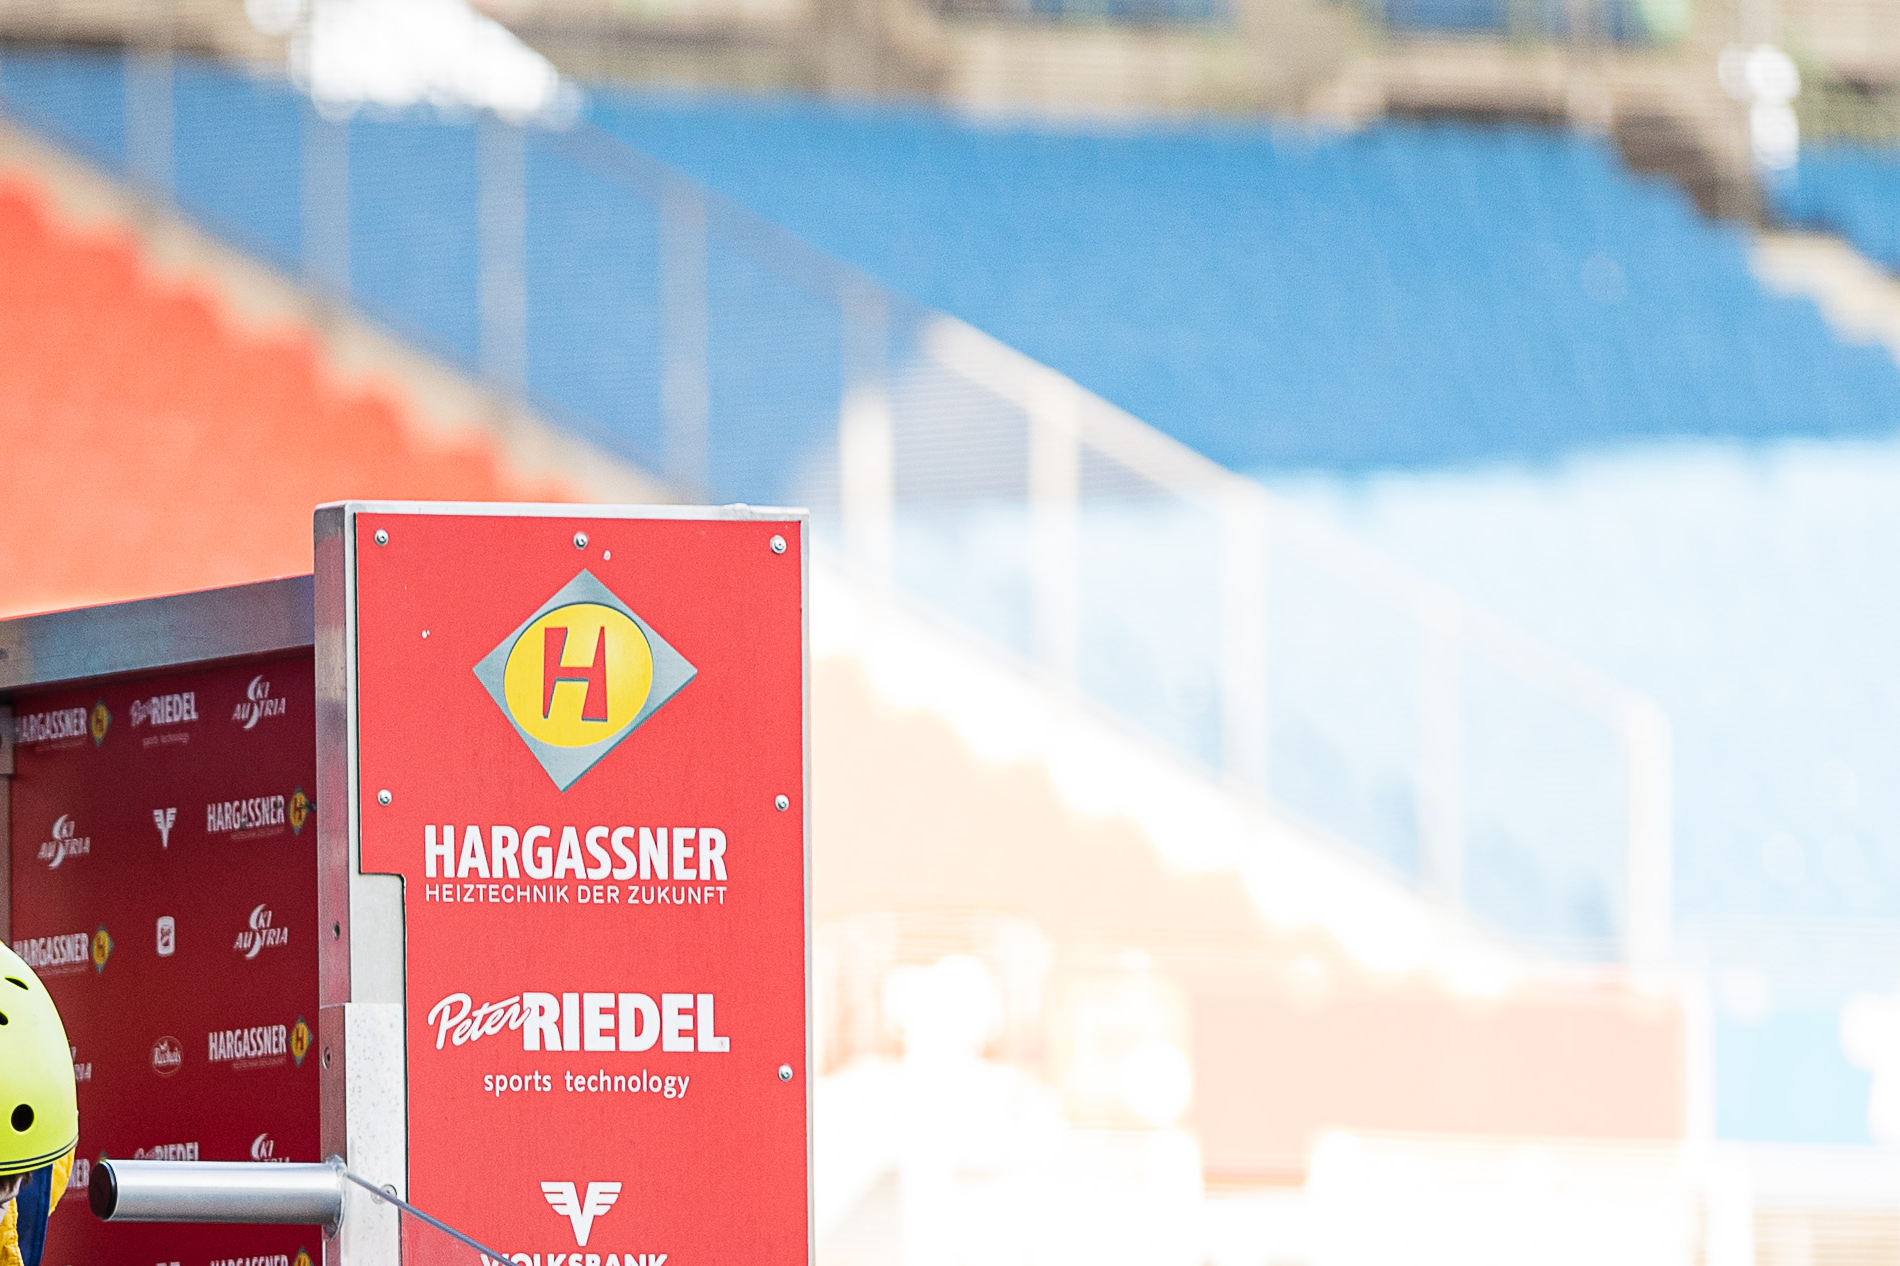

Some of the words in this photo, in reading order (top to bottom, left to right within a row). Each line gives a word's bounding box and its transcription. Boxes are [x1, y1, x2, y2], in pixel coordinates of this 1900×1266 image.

[150, 692, 198, 725] RIEDEL
[206, 796, 285, 832] HARGASSNER
[424, 824, 729, 882] HARGASSNER
[425, 883, 570, 904] HEIZTECHNIK
[577, 885, 620, 904] DER
[627, 885, 728, 905] ZUKUNFT
[427, 992, 531, 1050] Peter
[522, 992, 731, 1053] RIEDEL
[208, 1025, 287, 1063] HARGASSNER
[483, 1069, 552, 1097] sports
[564, 1069, 691, 1099] technology
